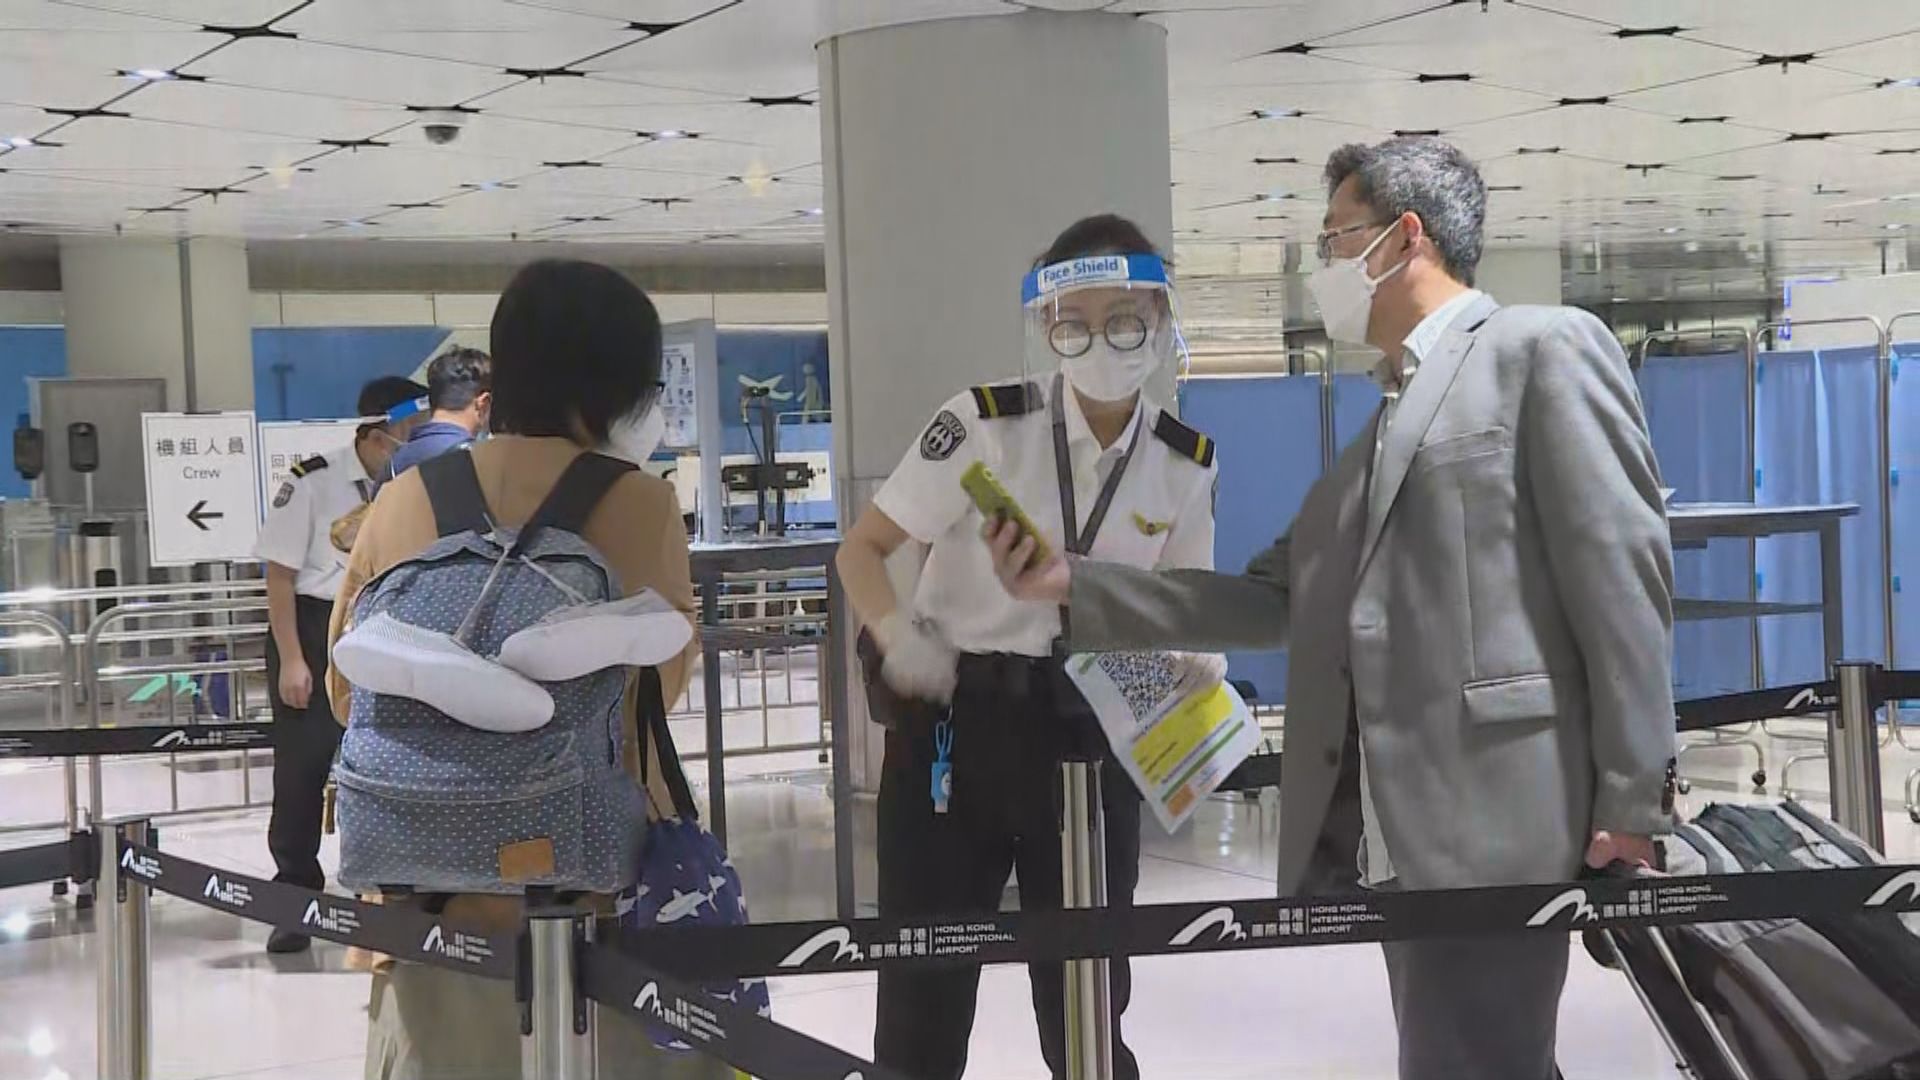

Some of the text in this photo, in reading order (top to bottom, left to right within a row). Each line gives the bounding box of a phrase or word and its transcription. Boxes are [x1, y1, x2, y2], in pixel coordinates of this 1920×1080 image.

[1044, 266, 1070, 282] Face
[1073, 258, 1118, 274] Shield
[155, 437, 245, 457] 機組人員
[182, 466, 220, 479] Crew
[1658, 884, 1711, 895] HONG KONG
[1658, 894, 1729, 904] INTERNATIONAL
[1311, 904, 1367, 914] HONG KONG
[1659, 905, 1697, 914] AIRPORT
[1311, 914, 1385, 924] INTERNATIONAL
[935, 923, 995, 934] HONG KONG
[1311, 925, 1352, 934] AIRPORT
[935, 934, 1015, 944] INTERNATIONAL
[935, 945, 979, 954] AIRPORT
